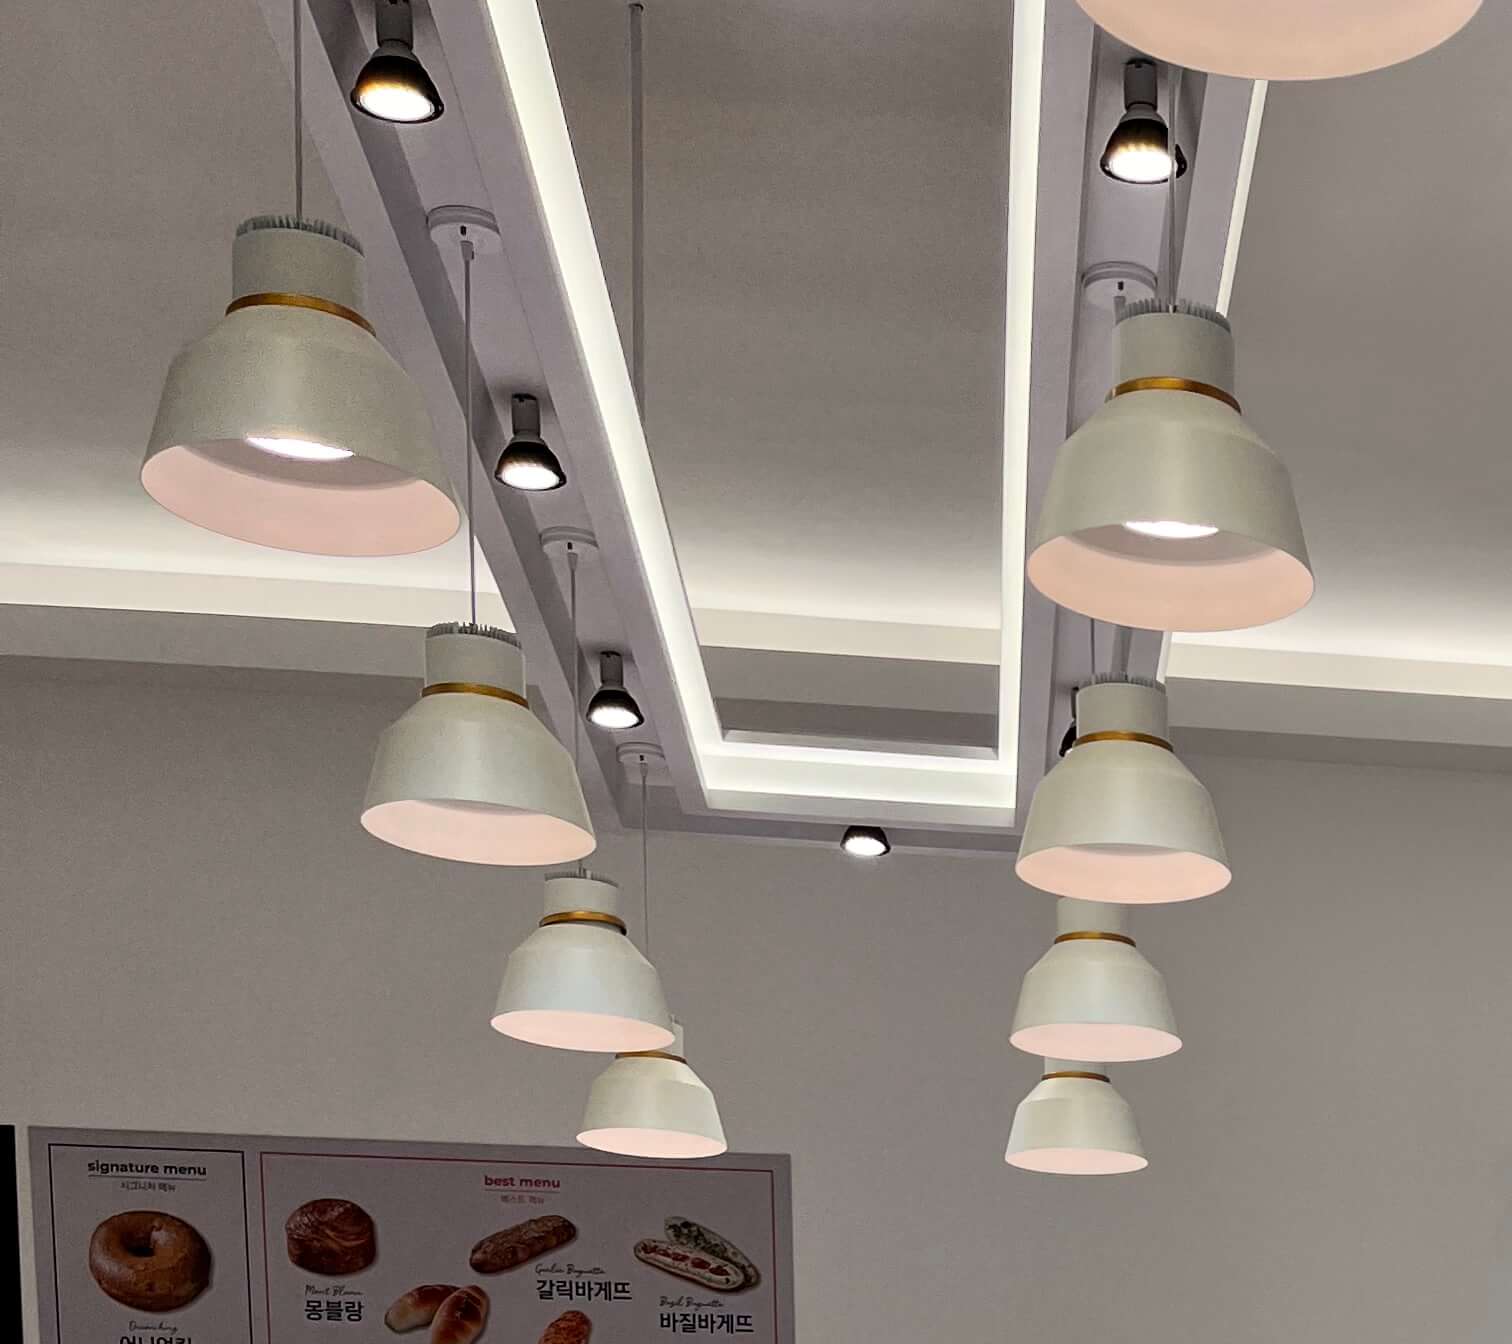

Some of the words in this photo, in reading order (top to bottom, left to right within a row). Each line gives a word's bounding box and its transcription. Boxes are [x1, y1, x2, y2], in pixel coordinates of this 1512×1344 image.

[87, 1160, 160, 1175] signature
[163, 1165, 207, 1176] menu
[484, 1175, 515, 1187] best
[519, 1178, 561, 1189] menu
[536, 1279, 633, 1302] 갈릭바게뜨
[304, 1300, 364, 1323] 몽블랑
[659, 1312, 755, 1335] 바질바게뜨
